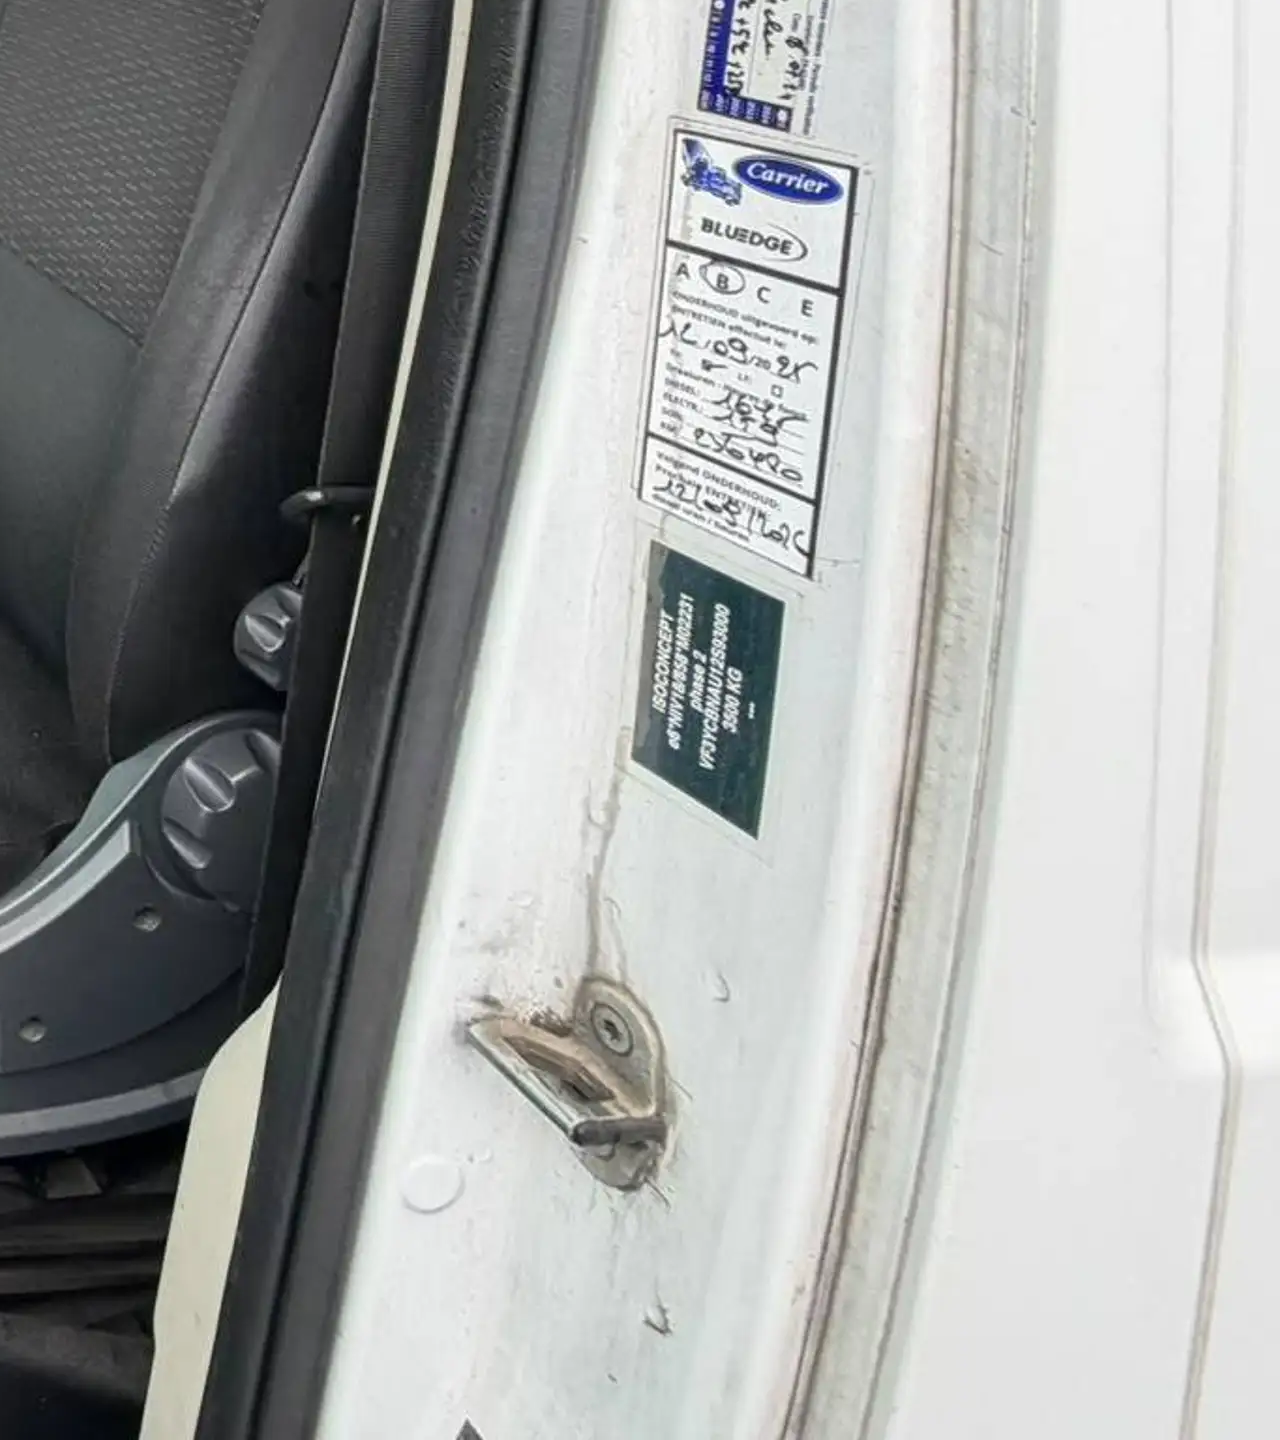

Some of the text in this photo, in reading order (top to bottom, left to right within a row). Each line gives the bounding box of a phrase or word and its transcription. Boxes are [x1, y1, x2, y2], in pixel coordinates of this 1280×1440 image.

[747, 161, 829, 195] Carrier
[701, 217, 793, 255] BLUEDGE
[675, 260, 814, 317] A B C E
[653, 609, 674, 714] ISOCONCEPT
[688, 647, 707, 714] phase 2
[722, 664, 744, 735] 3500 KG
